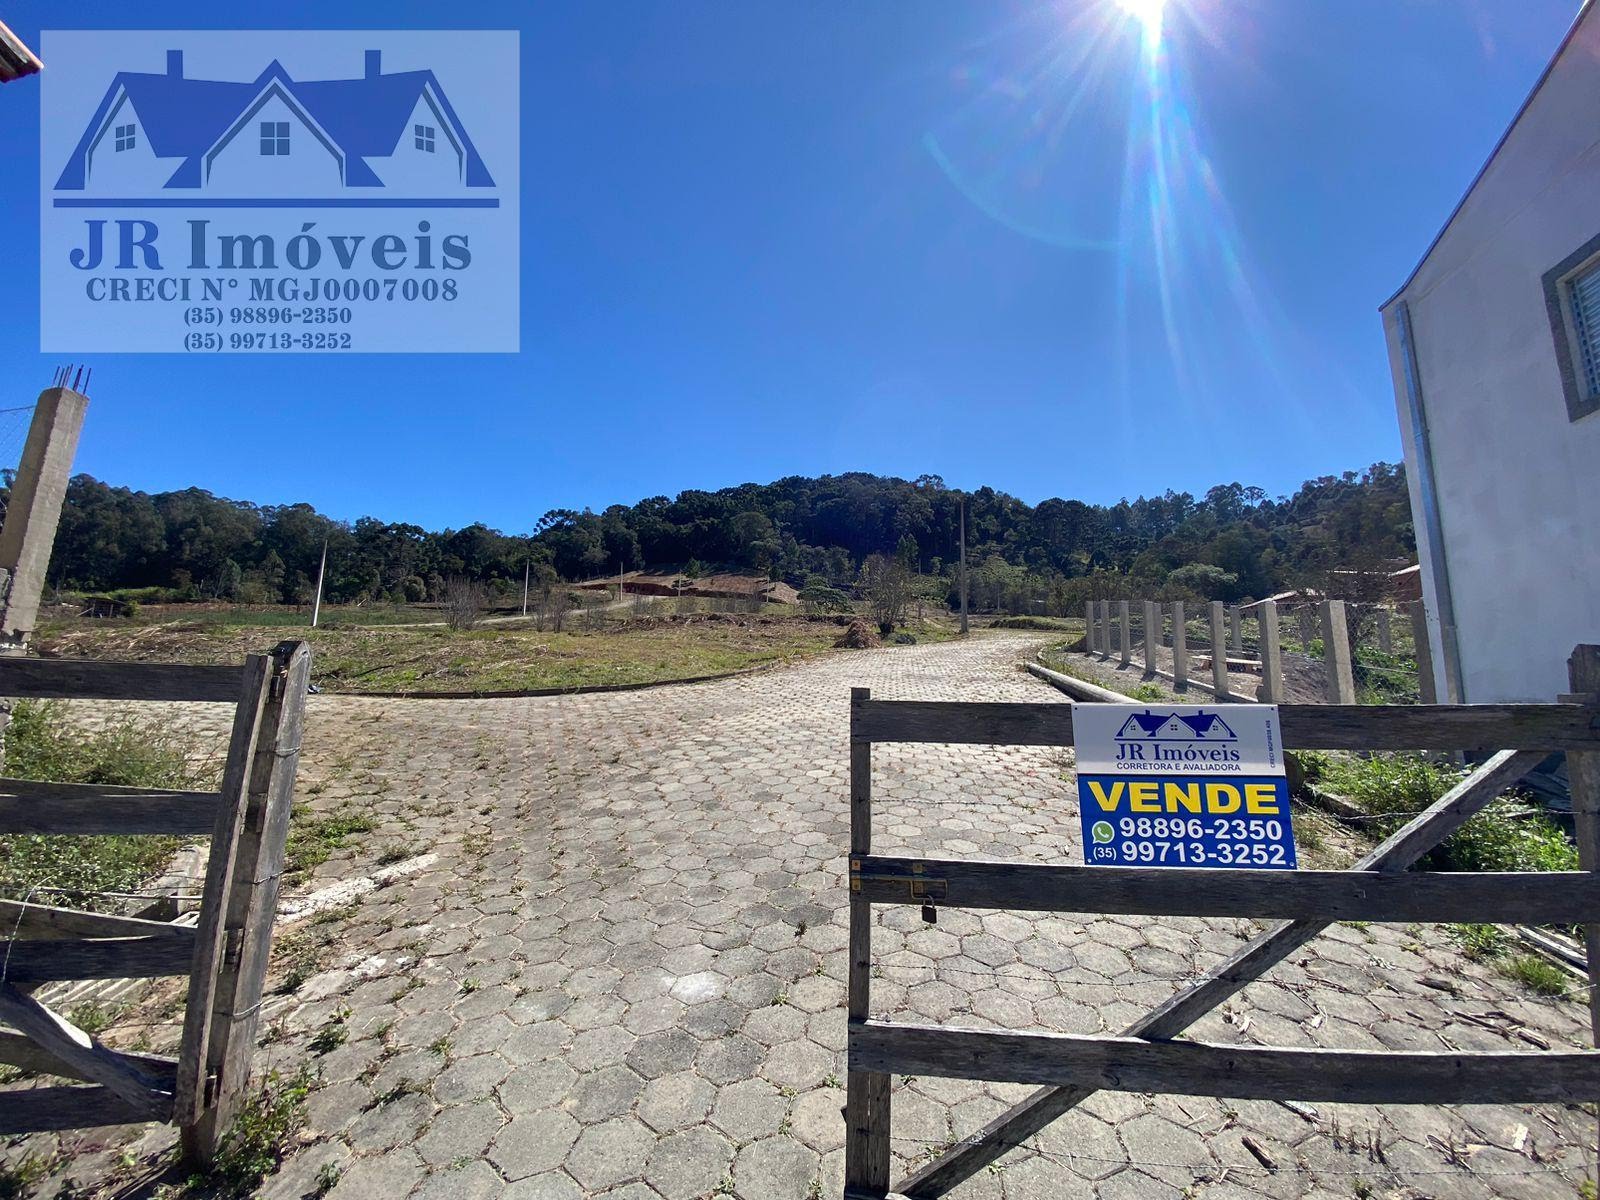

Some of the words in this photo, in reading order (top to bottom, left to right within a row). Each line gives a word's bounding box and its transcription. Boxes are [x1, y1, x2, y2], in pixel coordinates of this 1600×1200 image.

[1116, 743, 1145, 761] JR
[1153, 744, 1240, 761] Imóveis
[1117, 762, 1172, 770] CORRETORA
[1183, 763, 1241, 771] AVALIADORA
[1088, 781, 1280, 814] VENDE
[1119, 818, 1282, 840] 98896-2350
[1093, 847, 1117, 860] (35)
[1122, 842, 1286, 865] 99713-3252
